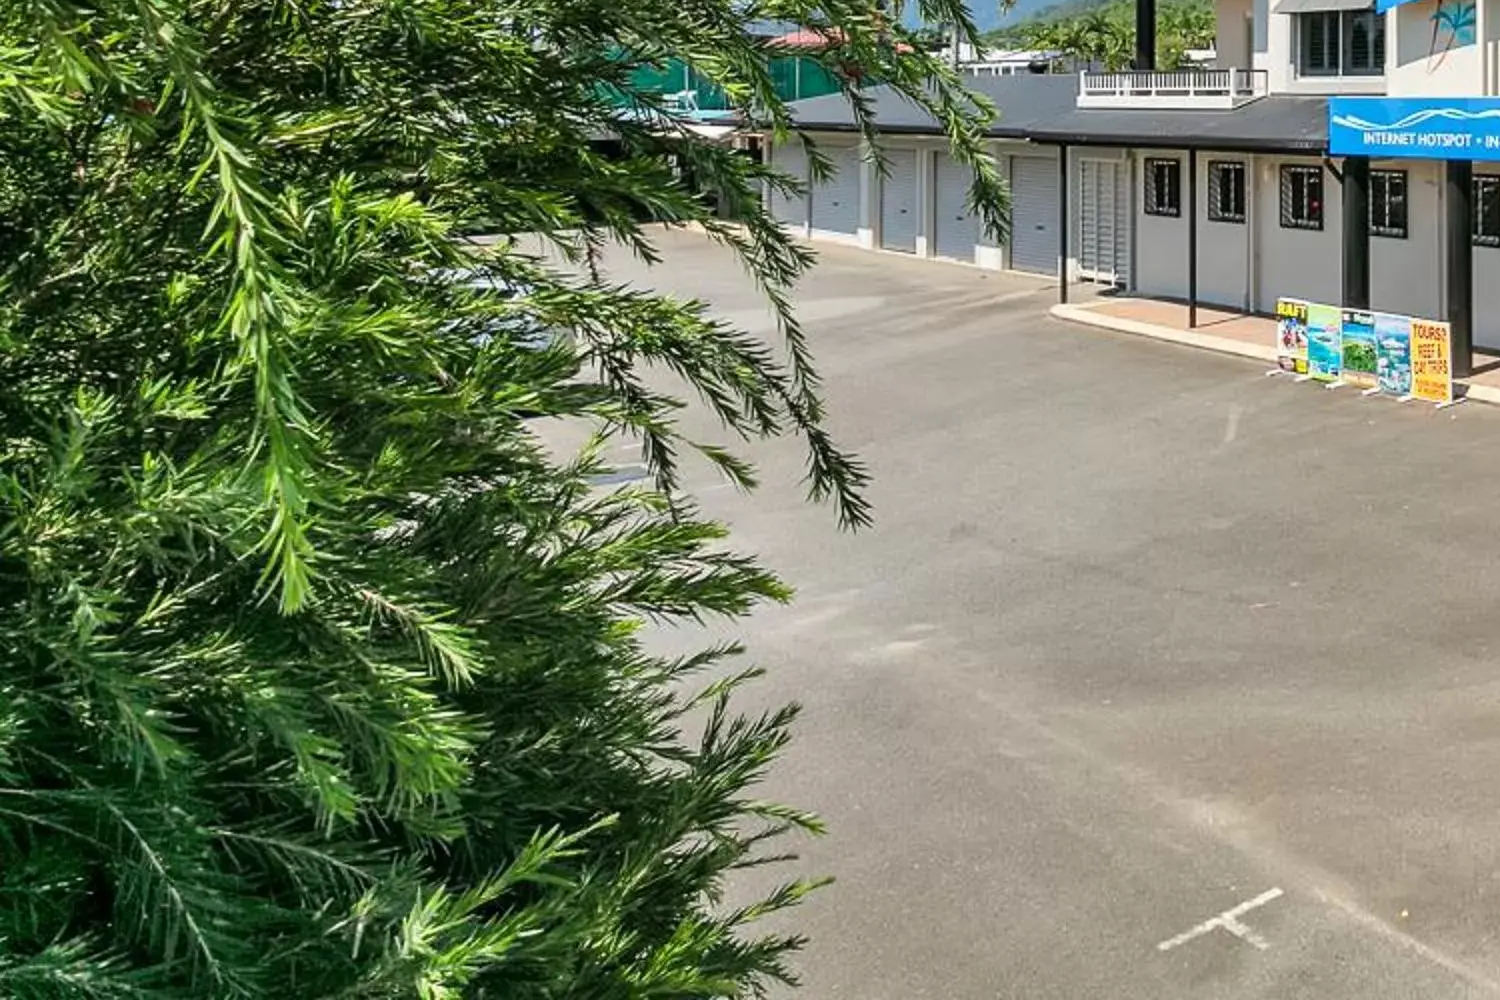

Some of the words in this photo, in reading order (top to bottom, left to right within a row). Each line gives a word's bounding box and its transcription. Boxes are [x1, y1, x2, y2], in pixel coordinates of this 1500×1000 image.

[1363, 131, 1416, 146] INTERNET
[1417, 133, 1473, 148] HOTSPOT
[1277, 302, 1307, 319] RAFT
